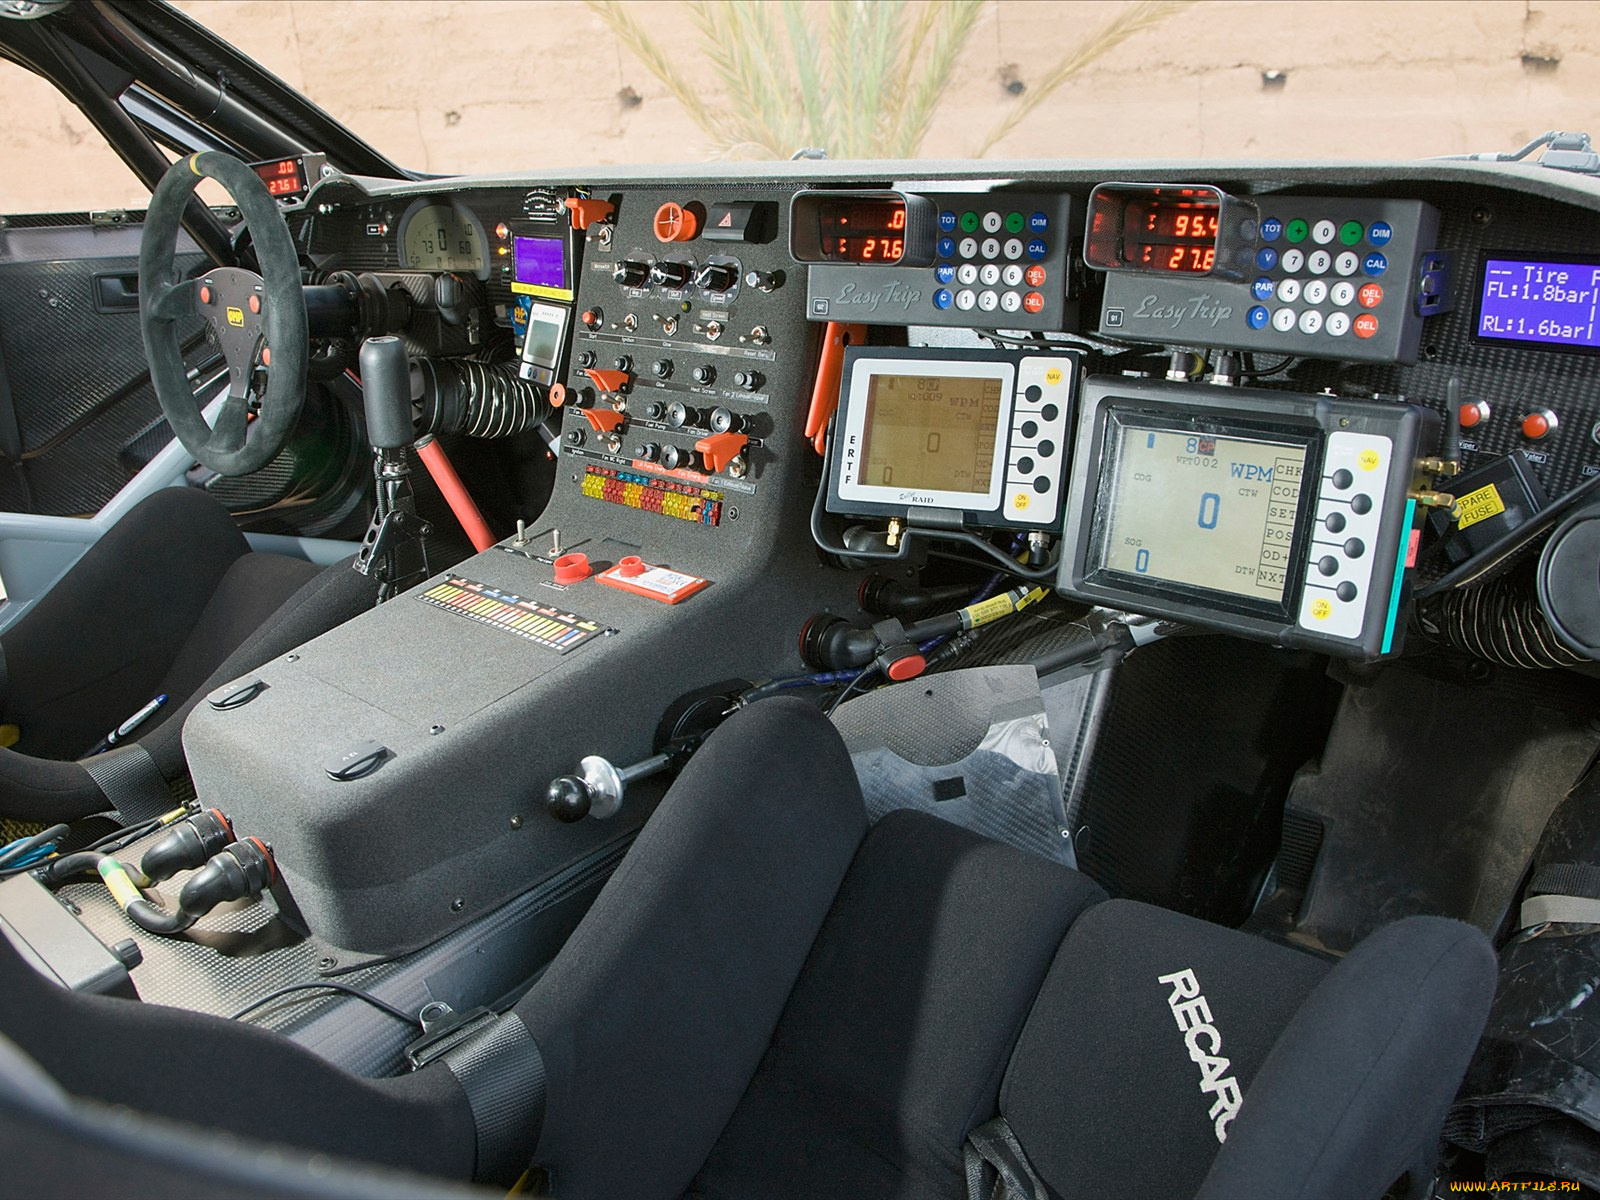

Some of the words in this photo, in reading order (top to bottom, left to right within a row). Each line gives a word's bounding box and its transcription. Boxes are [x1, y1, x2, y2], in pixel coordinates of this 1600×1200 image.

[941, 216, 956, 224] TOT
[990, 218, 996, 227] 0
[1032, 218, 1046, 226] DIM
[1265, 224, 1281, 232] TOT
[1323, 228, 1329, 237] 0
[1372, 229, 1390, 238] DIM
[863, 239, 903, 258] 27.6
[944, 242, 950, 250] V
[966, 244, 972, 252] 7
[988, 244, 994, 253] 8
[1011, 245, 1017, 253] 9
[1029, 245, 1045, 253] CAL
[1292, 256, 1298, 265] 7
[1318, 257, 1324, 267] 8
[1345, 259, 1351, 268] 9
[1367, 260, 1385, 268] CAL
[965, 270, 970, 278] 4
[987, 271, 993, 279] 5
[1009, 272, 1015, 280] 6
[1524, 265, 1568, 284] Tire
[1255, 282, 1273, 291] PAR
[1287, 286, 1293, 294] 4
[835, 282, 882, 312] Easy
[884, 280, 922, 310] Trip
[1314, 288, 1320, 297] 5
[1340, 289, 1346, 299] 6
[1362, 289, 1380, 298] DEL
[986, 297, 991, 305] 2
[1008, 298, 1013, 306] 3
[1025, 298, 1041, 306] DEL
[1367, 298, 1373, 306] P
[1133, 294, 1187, 328] Easy
[1189, 293, 1233, 327] Trip
[1256, 312, 1263, 320] C
[1309, 318, 1315, 327] 2
[1336, 320, 1341, 329] 3
[1357, 321, 1375, 330] DEL
[927, 432, 940, 453] 0
[1186, 438, 1198, 454] 8
[1361, 456, 1377, 465] NAV
[1231, 462, 1274, 483] WPM
[1276, 464, 1303, 477] CHK
[883, 466, 892, 485] 0
[1133, 473, 1152, 482] COG
[1238, 488, 1259, 498] CTW
[1272, 486, 1299, 498] COD
[912, 496, 934, 504] RAID
[1197, 492, 1221, 529] 0
[1269, 507, 1295, 520] SET
[1464, 503, 1493, 522] FUSE
[1266, 528, 1292, 541] POS
[1124, 537, 1143, 548] SOG
[1262, 549, 1288, 561] OD+
[1135, 549, 1149, 573] 0
[1235, 565, 1255, 577] DTW
[1258, 570, 1285, 584] NXT
[1316, 601, 1328, 609] ON
[1312, 609, 1328, 618] OFF
